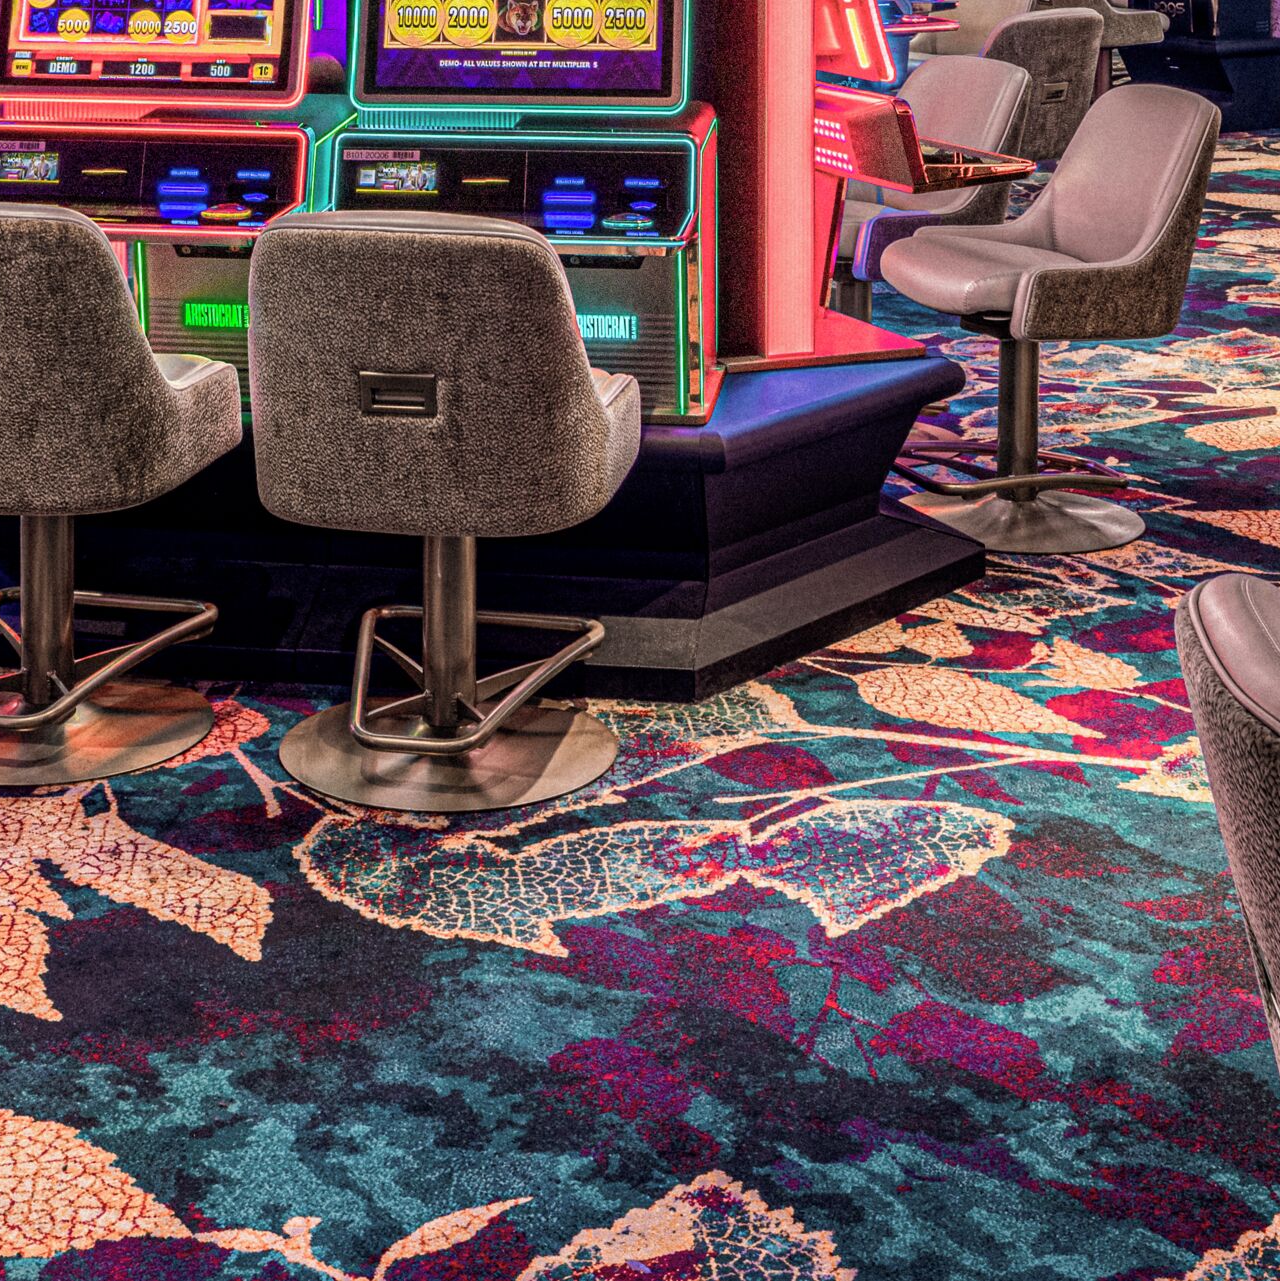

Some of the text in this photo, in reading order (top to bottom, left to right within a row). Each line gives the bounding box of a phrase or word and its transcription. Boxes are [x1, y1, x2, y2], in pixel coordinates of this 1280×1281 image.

[398, 7, 646, 28] 10000 2000 5000 2500
[57, 20, 196, 35] 5000 10000 2500
[463, 60, 474, 68] ALL
[185, 303, 243, 328] ARISTOCRAT
